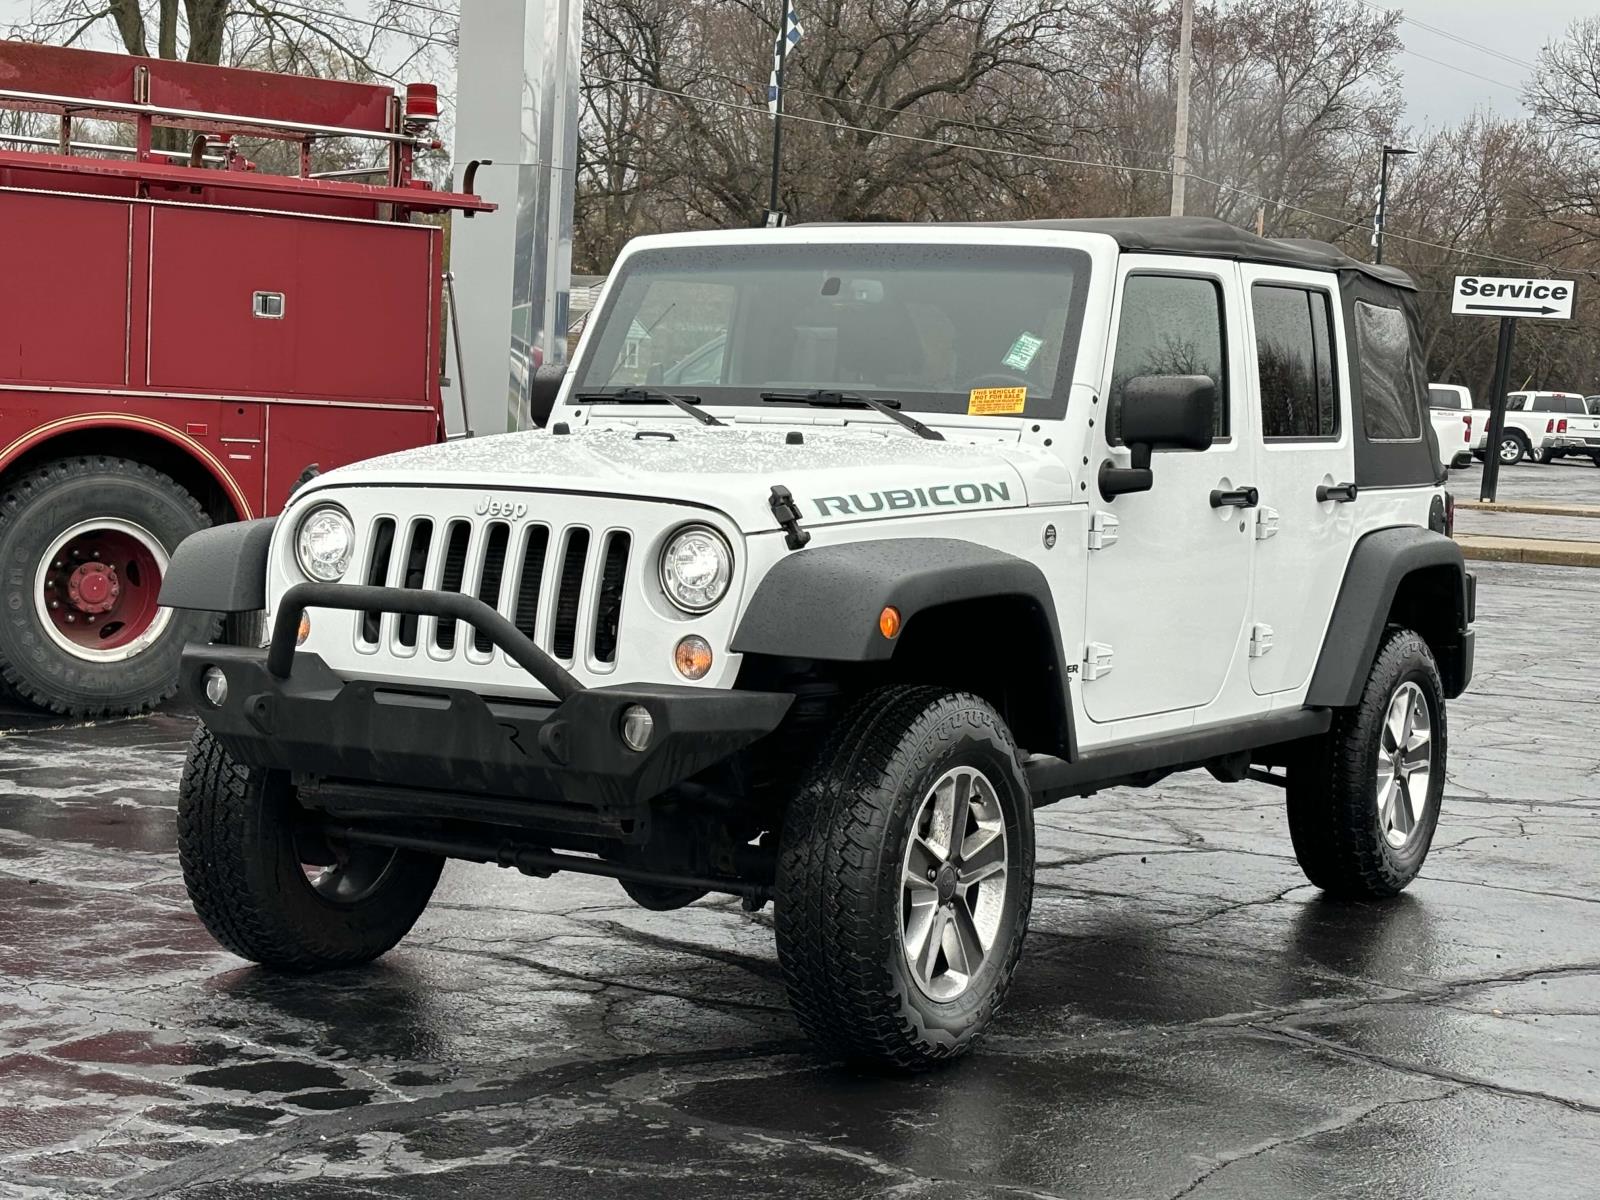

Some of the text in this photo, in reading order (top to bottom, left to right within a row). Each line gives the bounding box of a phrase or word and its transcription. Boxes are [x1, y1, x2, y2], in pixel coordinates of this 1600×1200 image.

[1460, 278, 1568, 300] Service
[474, 494, 528, 522] Jeep
[812, 481, 1011, 516] RUBICON
[1066, 664, 1079, 673] ER
